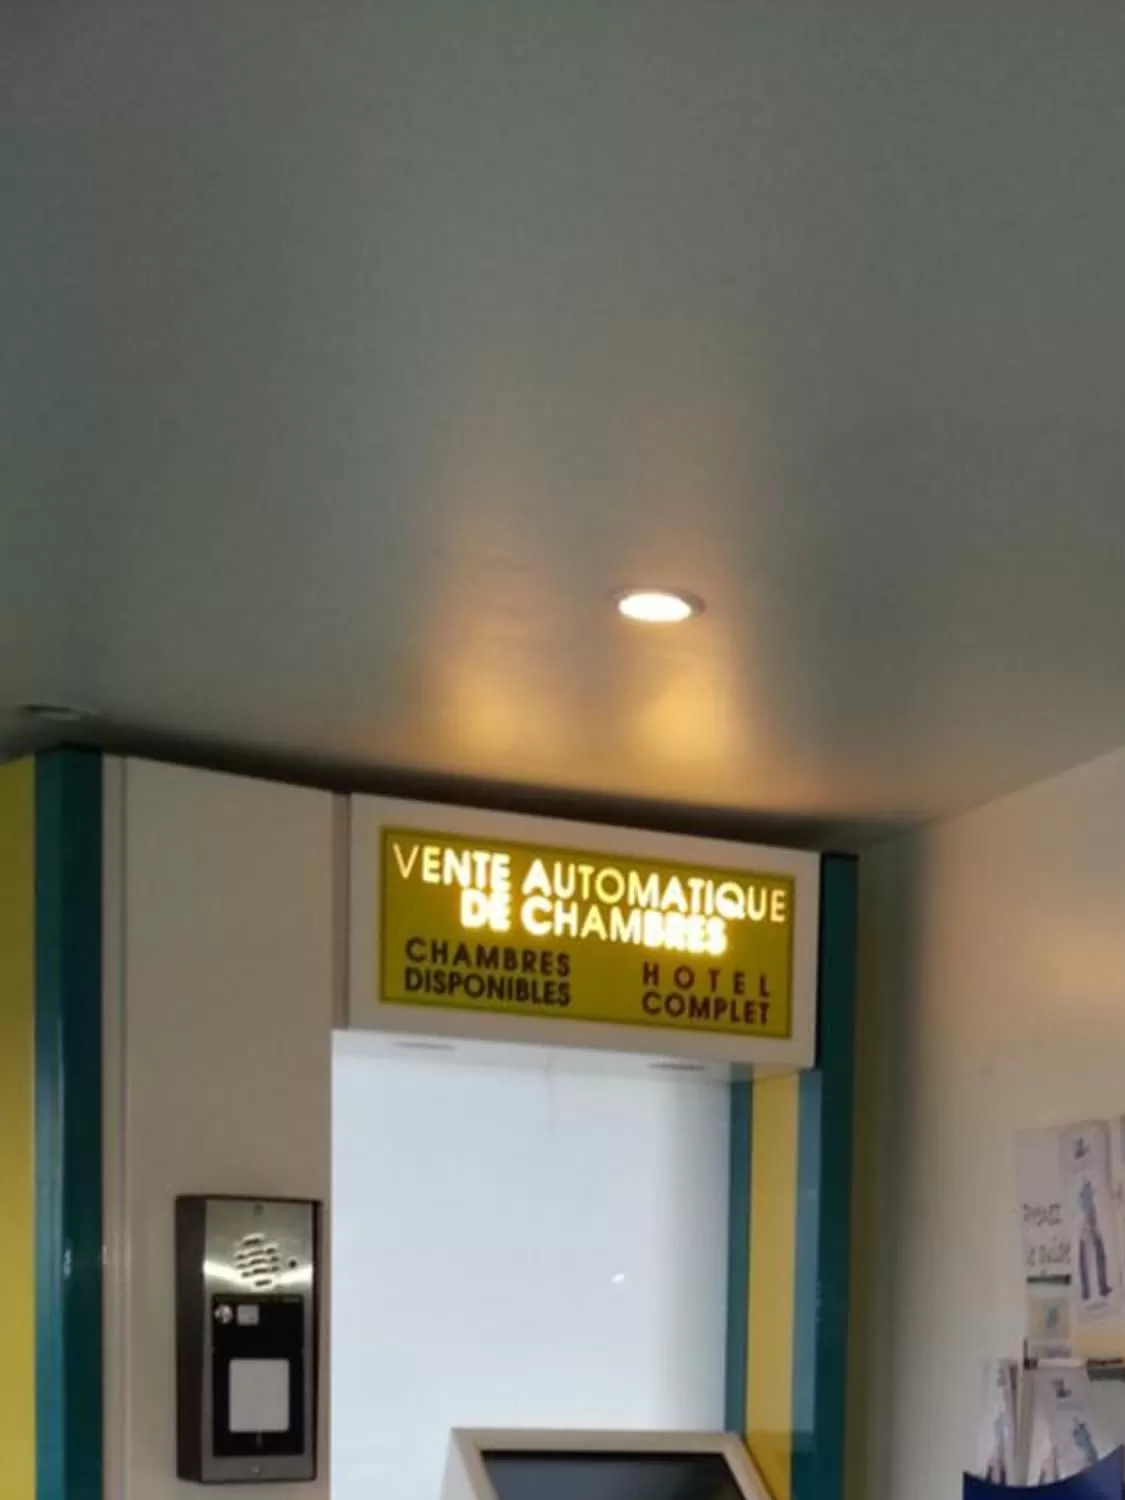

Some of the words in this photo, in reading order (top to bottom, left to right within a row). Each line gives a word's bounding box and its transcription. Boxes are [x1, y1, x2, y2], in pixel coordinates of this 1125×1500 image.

[393, 843, 511, 890] VENTE
[521, 858, 786, 923] AUTOMATIQUE
[460, 888, 511, 932] DE
[520, 896, 729, 955] CHAMBRES
[404, 936, 571, 977] CHAMBRES
[404, 967, 571, 1008] DISPONIBLES
[642, 961, 770, 998] HOTEL
[641, 991, 770, 1025] COMPLET
